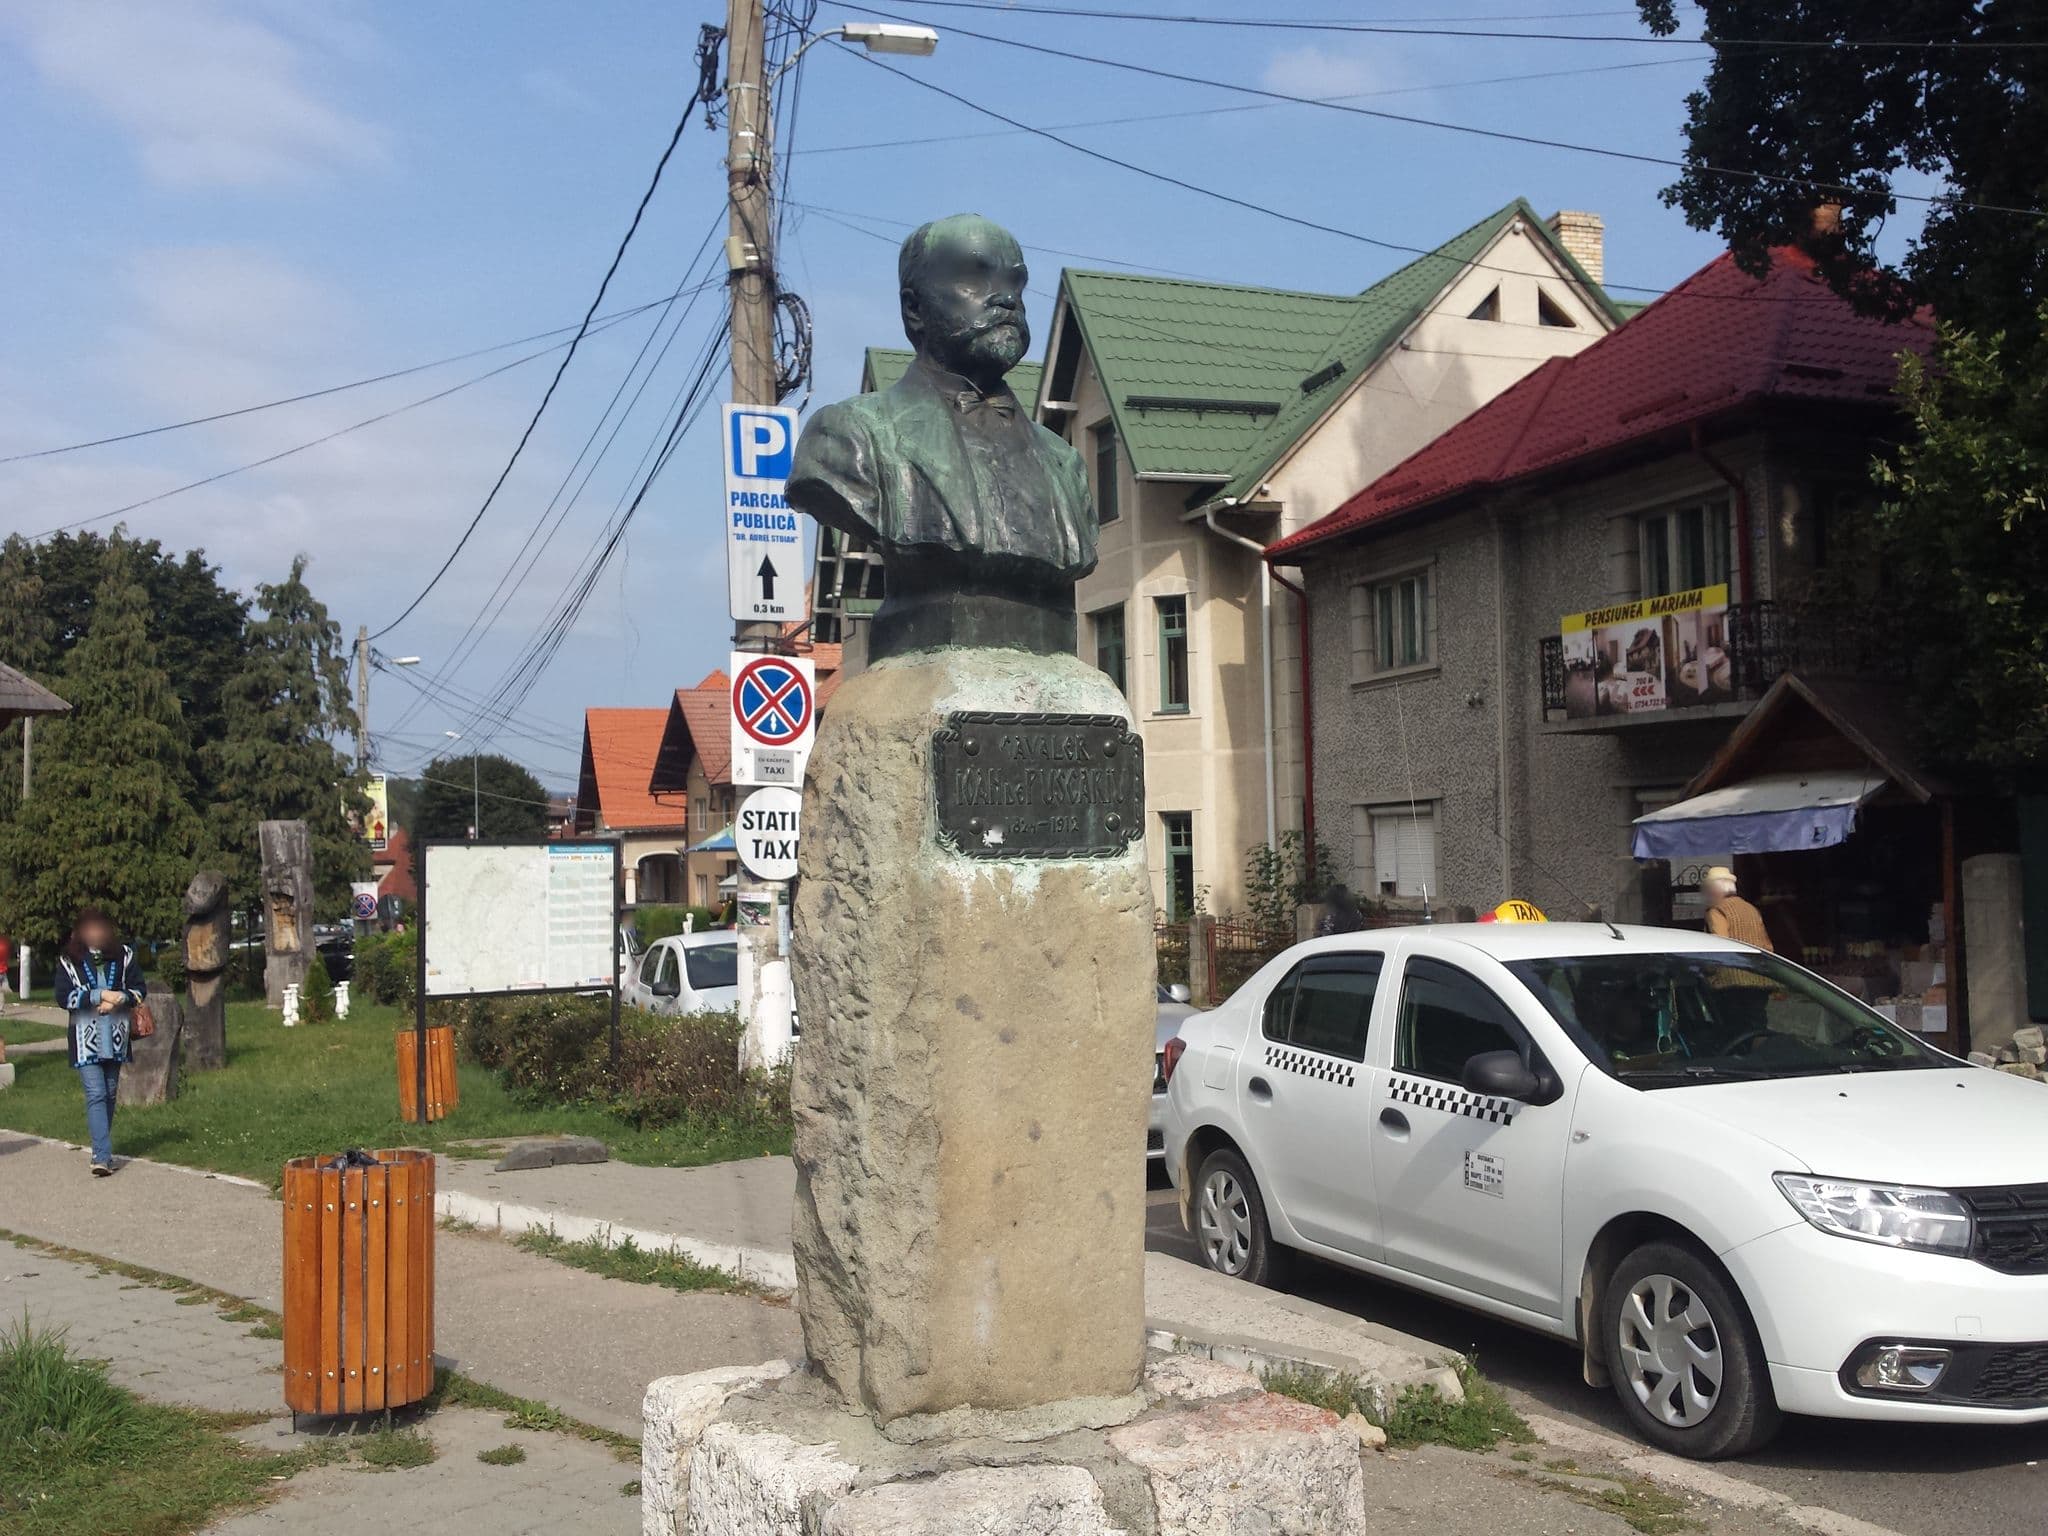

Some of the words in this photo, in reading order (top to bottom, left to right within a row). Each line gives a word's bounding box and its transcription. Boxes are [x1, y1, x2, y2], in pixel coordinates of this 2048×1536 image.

[740, 414, 786, 475] P
[731, 491, 790, 509] PARCAR
[753, 605, 767, 614] 0,3
[770, 605, 784, 614] km
[1584, 603, 1643, 627] PENSIUNEA
[1650, 591, 1703, 615] MARIANA
[763, 766, 785, 775] TAXI
[742, 810, 797, 831] STATI
[752, 839, 799, 860] TAXI
[1509, 903, 1540, 921] TAXI
